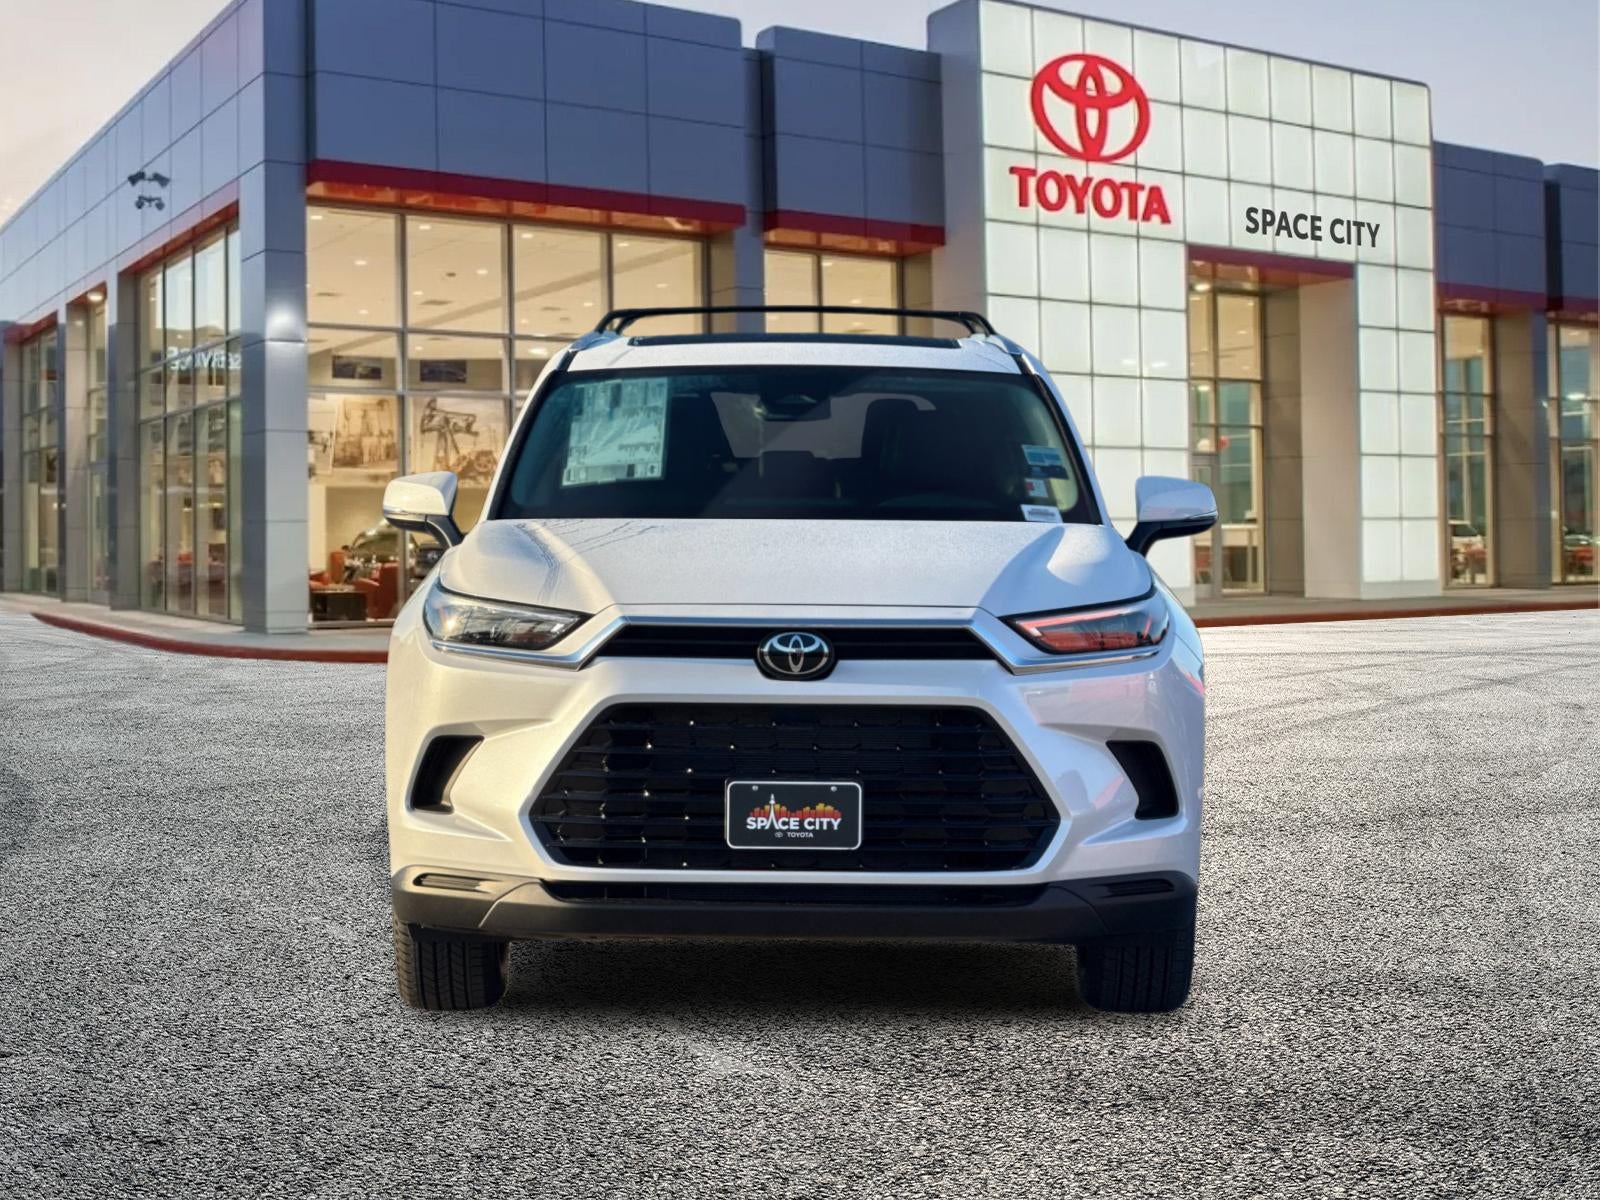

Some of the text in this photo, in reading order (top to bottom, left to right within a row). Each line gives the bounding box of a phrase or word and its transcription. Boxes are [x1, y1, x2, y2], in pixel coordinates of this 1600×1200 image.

[1009, 166, 1171, 224] TOYOTA
[1245, 206, 1381, 248] SPACE CITY
[746, 817, 842, 830] SPACE CITY
